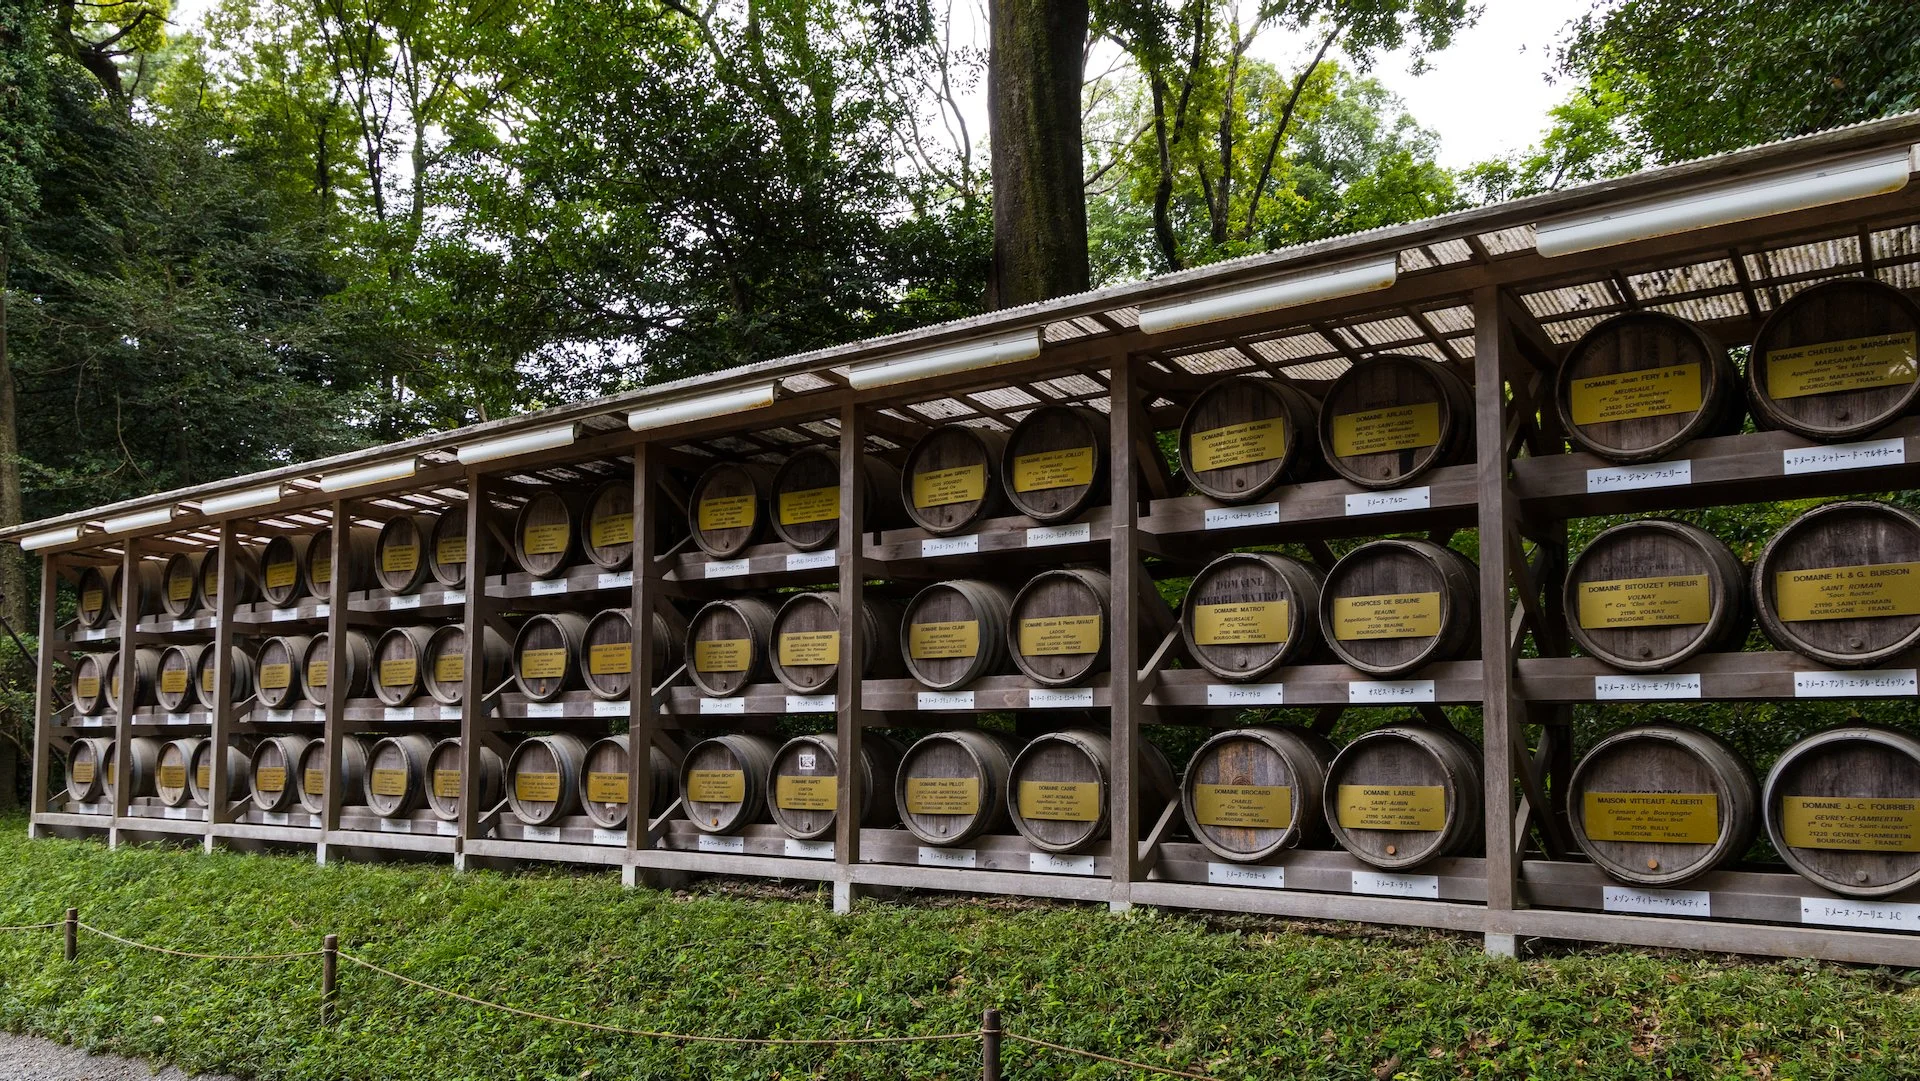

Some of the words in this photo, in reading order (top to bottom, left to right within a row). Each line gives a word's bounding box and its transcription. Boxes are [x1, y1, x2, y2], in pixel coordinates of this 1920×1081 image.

[1773, 351, 1803, 362] DOMAINE
[1846, 342, 1858, 351] de
[1860, 335, 1912, 350] MARSANNAY
[1814, 354, 1865, 367] MARSANNAY
[1584, 378, 1617, 389] DOMAINE
[1620, 375, 1638, 384] Jean
[1672, 369, 1685, 377] Fils
[1829, 368, 1874, 380] MARSANNAY
[1799, 379, 1842, 391] BOURGOGNE
[1856, 374, 1883, 384] FRANCE
[1613, 384, 1655, 395] MEURSAULT
[1624, 397, 1665, 408] ECHEVRONNE
[1355, 413, 1382, 422] DOMAINE
[1386, 409, 1412, 418] ARLAUD
[1599, 407, 1637, 418] BOURGOGNE
[1647, 403, 1671, 412] FRANCE
[1793, 573, 1831, 582] DOMAINE
[1836, 571, 1844, 579] H.
[1847, 571, 1853, 579] &
[1856, 570, 1864, 578] G.
[1868, 567, 1908, 577] BUISSON
[1624, 582, 1663, 590] BITOUZET
[1667, 579, 1697, 587] PRIEUR
[1819, 584, 1844, 592] SAINT
[1835, 597, 1891, 607] SAINT-ROMAIN
[1809, 607, 1855, 615] BOURGOGNE
[1867, 604, 1895, 612] FRANCE
[1606, 615, 1644, 623] BOURGOGNE
[1597, 796, 1626, 804] MAISON
[1802, 801, 1840, 809] DOMAINE
[1870, 802, 1914, 811] FOURRIER
[1651, 810, 1692, 818] Bourgogne
[1814, 814, 1903, 823] GEVREY-CHAMBERTIN
[1831, 831, 1911, 839] GEVREY-CHAMBERTIN
[1815, 837, 1861, 845] BOURGOGNE
